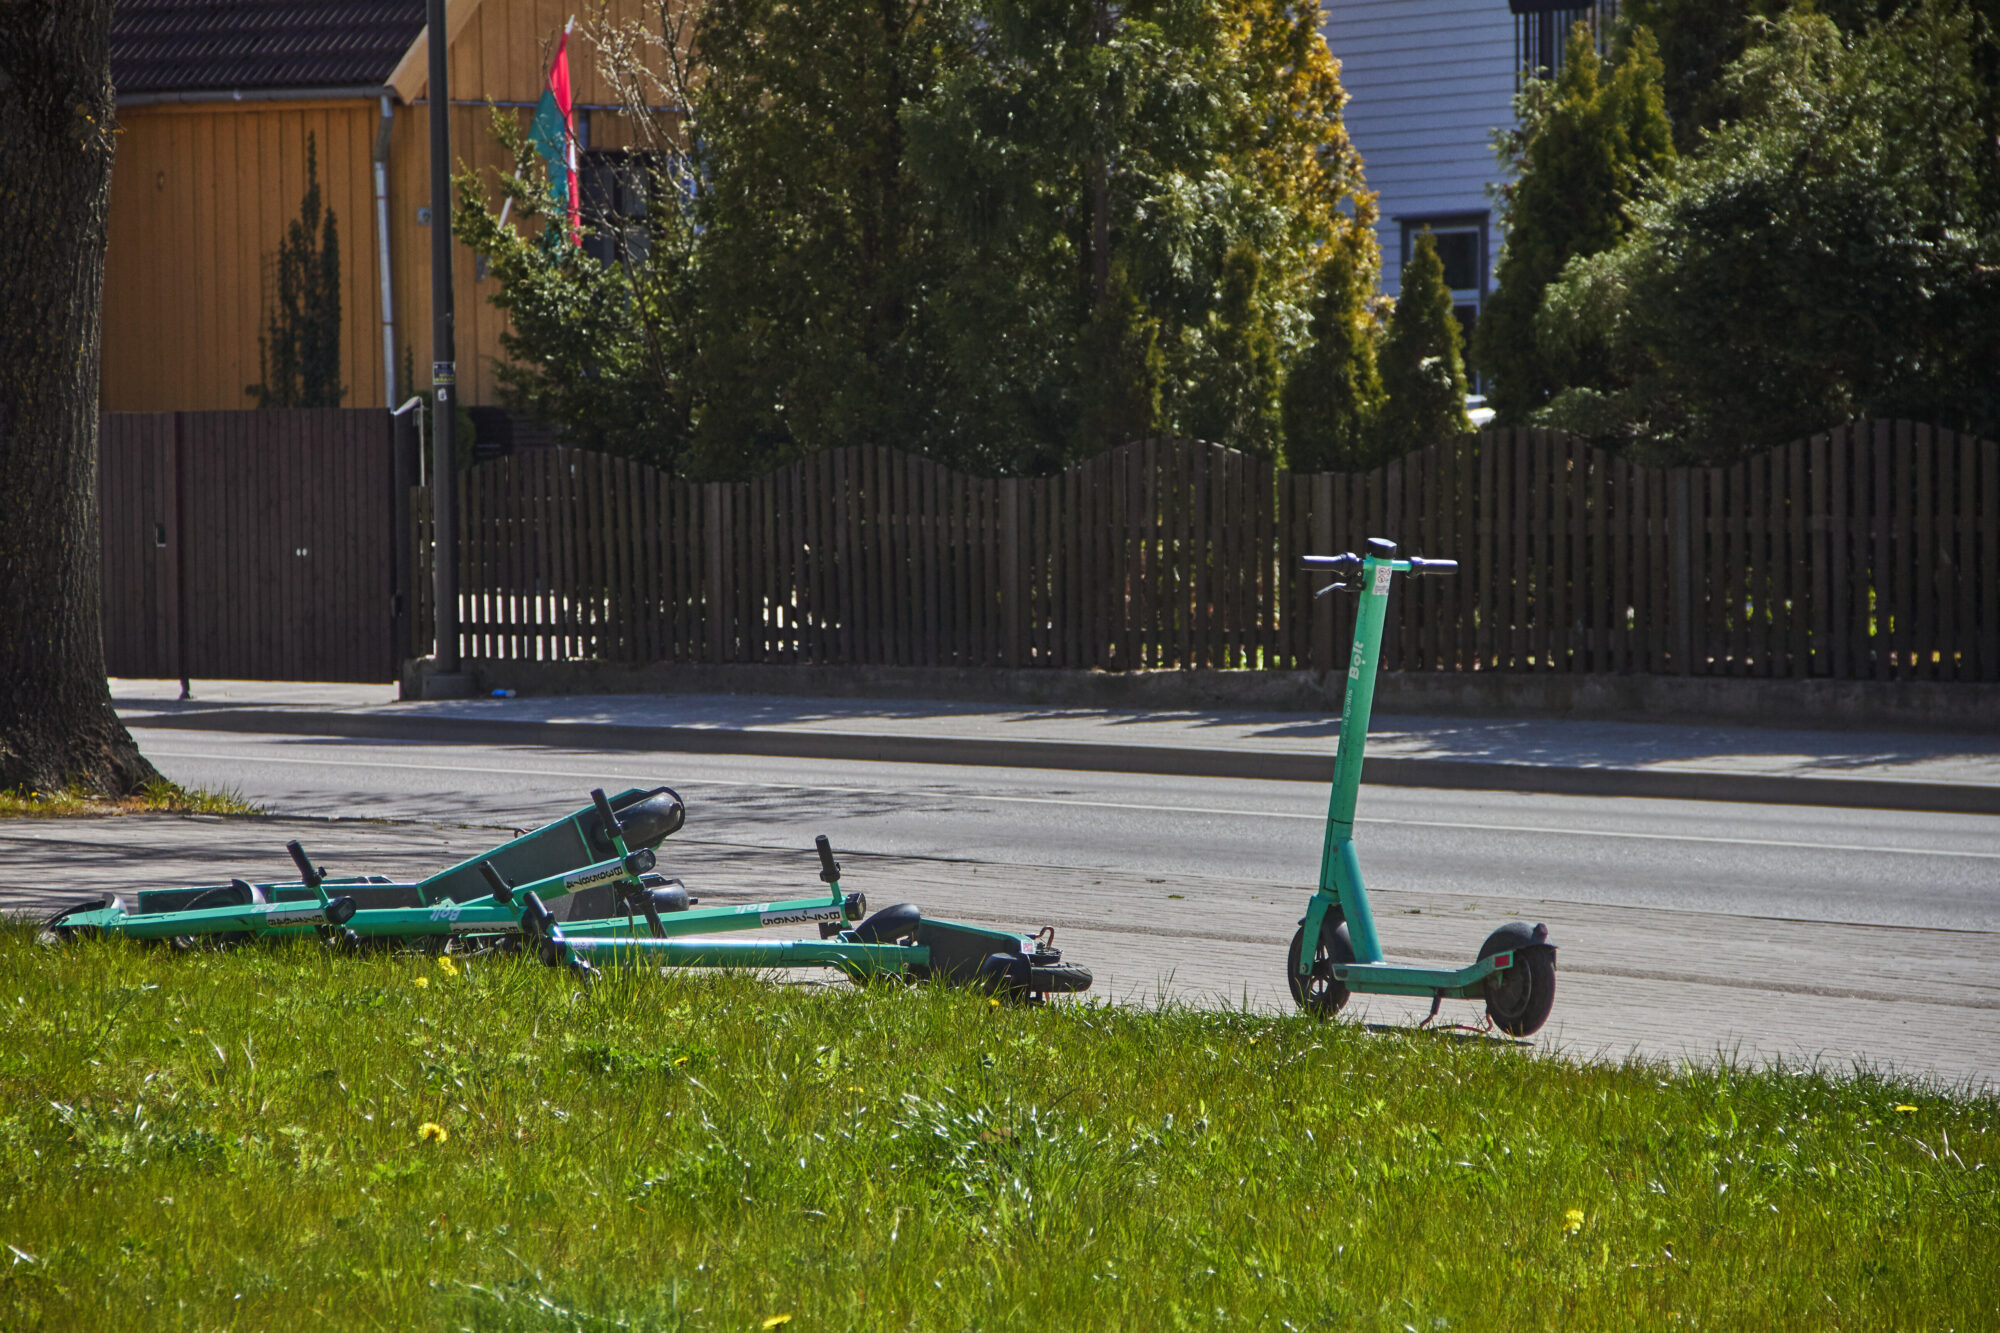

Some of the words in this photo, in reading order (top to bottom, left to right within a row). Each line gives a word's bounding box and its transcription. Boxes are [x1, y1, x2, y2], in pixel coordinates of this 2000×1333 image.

[1349, 641, 1364, 680] Bolt
[430, 908, 461, 921] Bolt
[735, 903, 770, 914] Bolt
[762, 911, 841, 925] B272265
